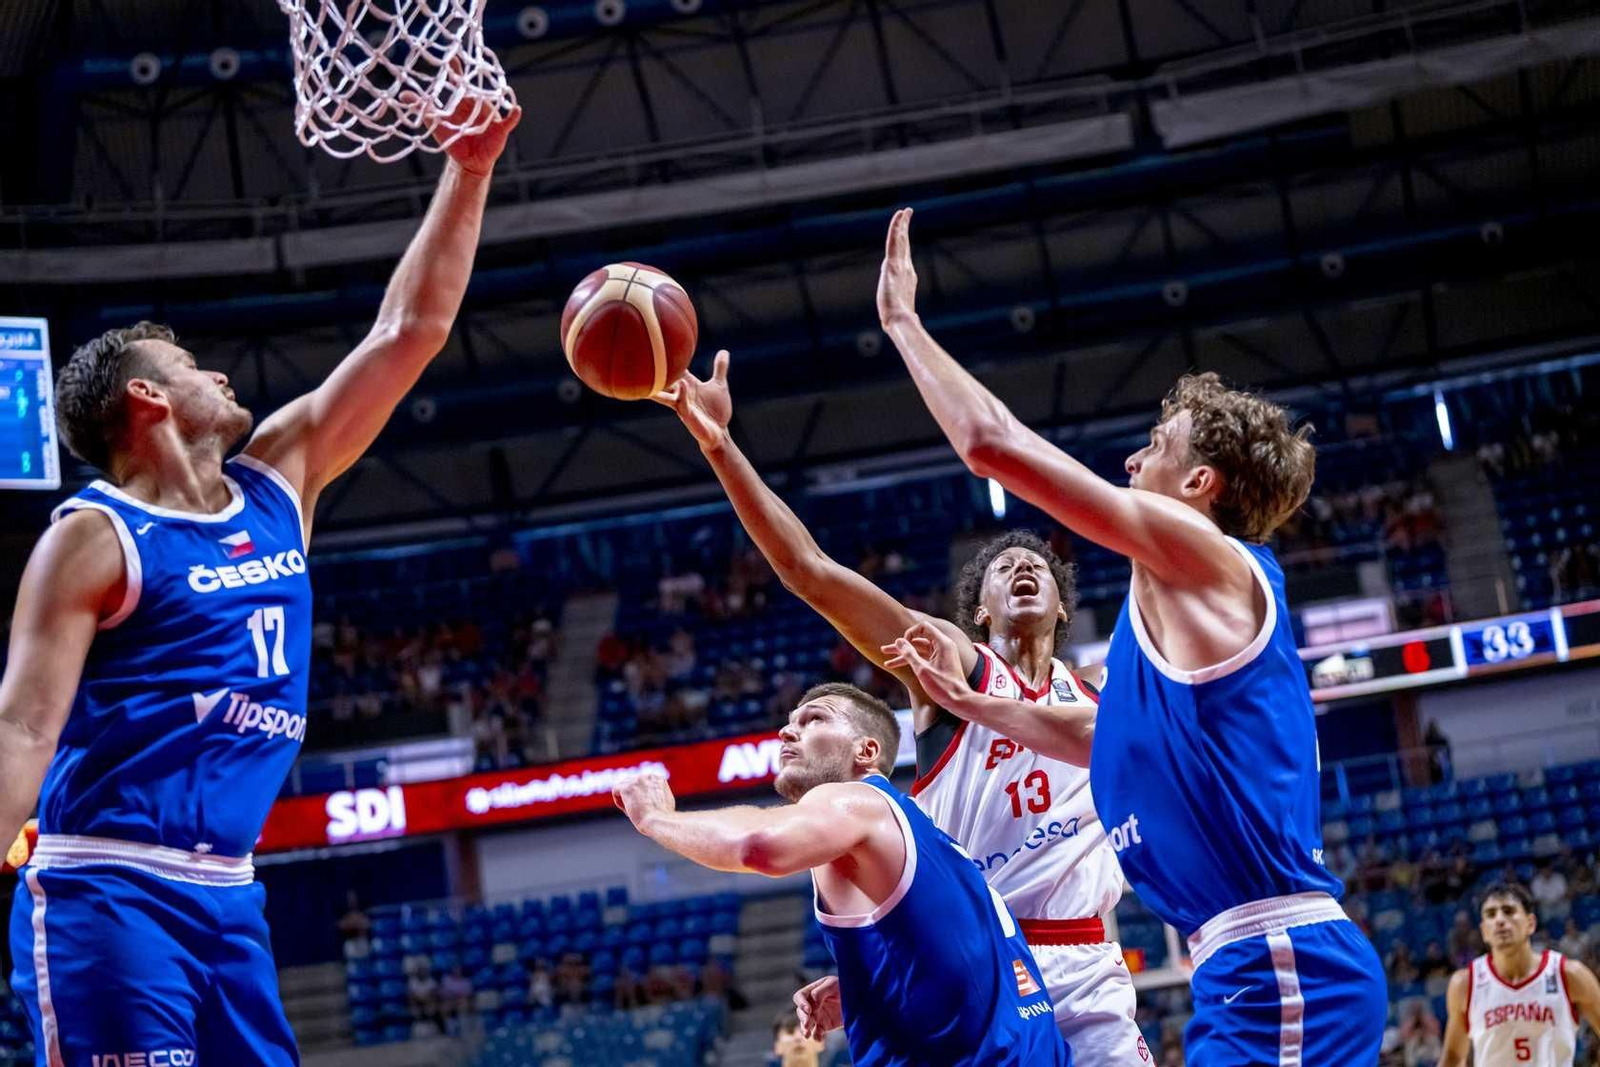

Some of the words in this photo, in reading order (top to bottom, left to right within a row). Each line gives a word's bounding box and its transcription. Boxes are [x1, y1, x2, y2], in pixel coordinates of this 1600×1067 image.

[188, 549, 306, 593] ČESKO
[247, 606, 290, 678] 17
[1482, 621, 1534, 663] 33
[326, 785, 406, 839] SDI
[1005, 769, 1051, 818] 13
[1484, 1002, 1555, 1030] ESPAÑA
[1514, 1036, 1531, 1061] 5
